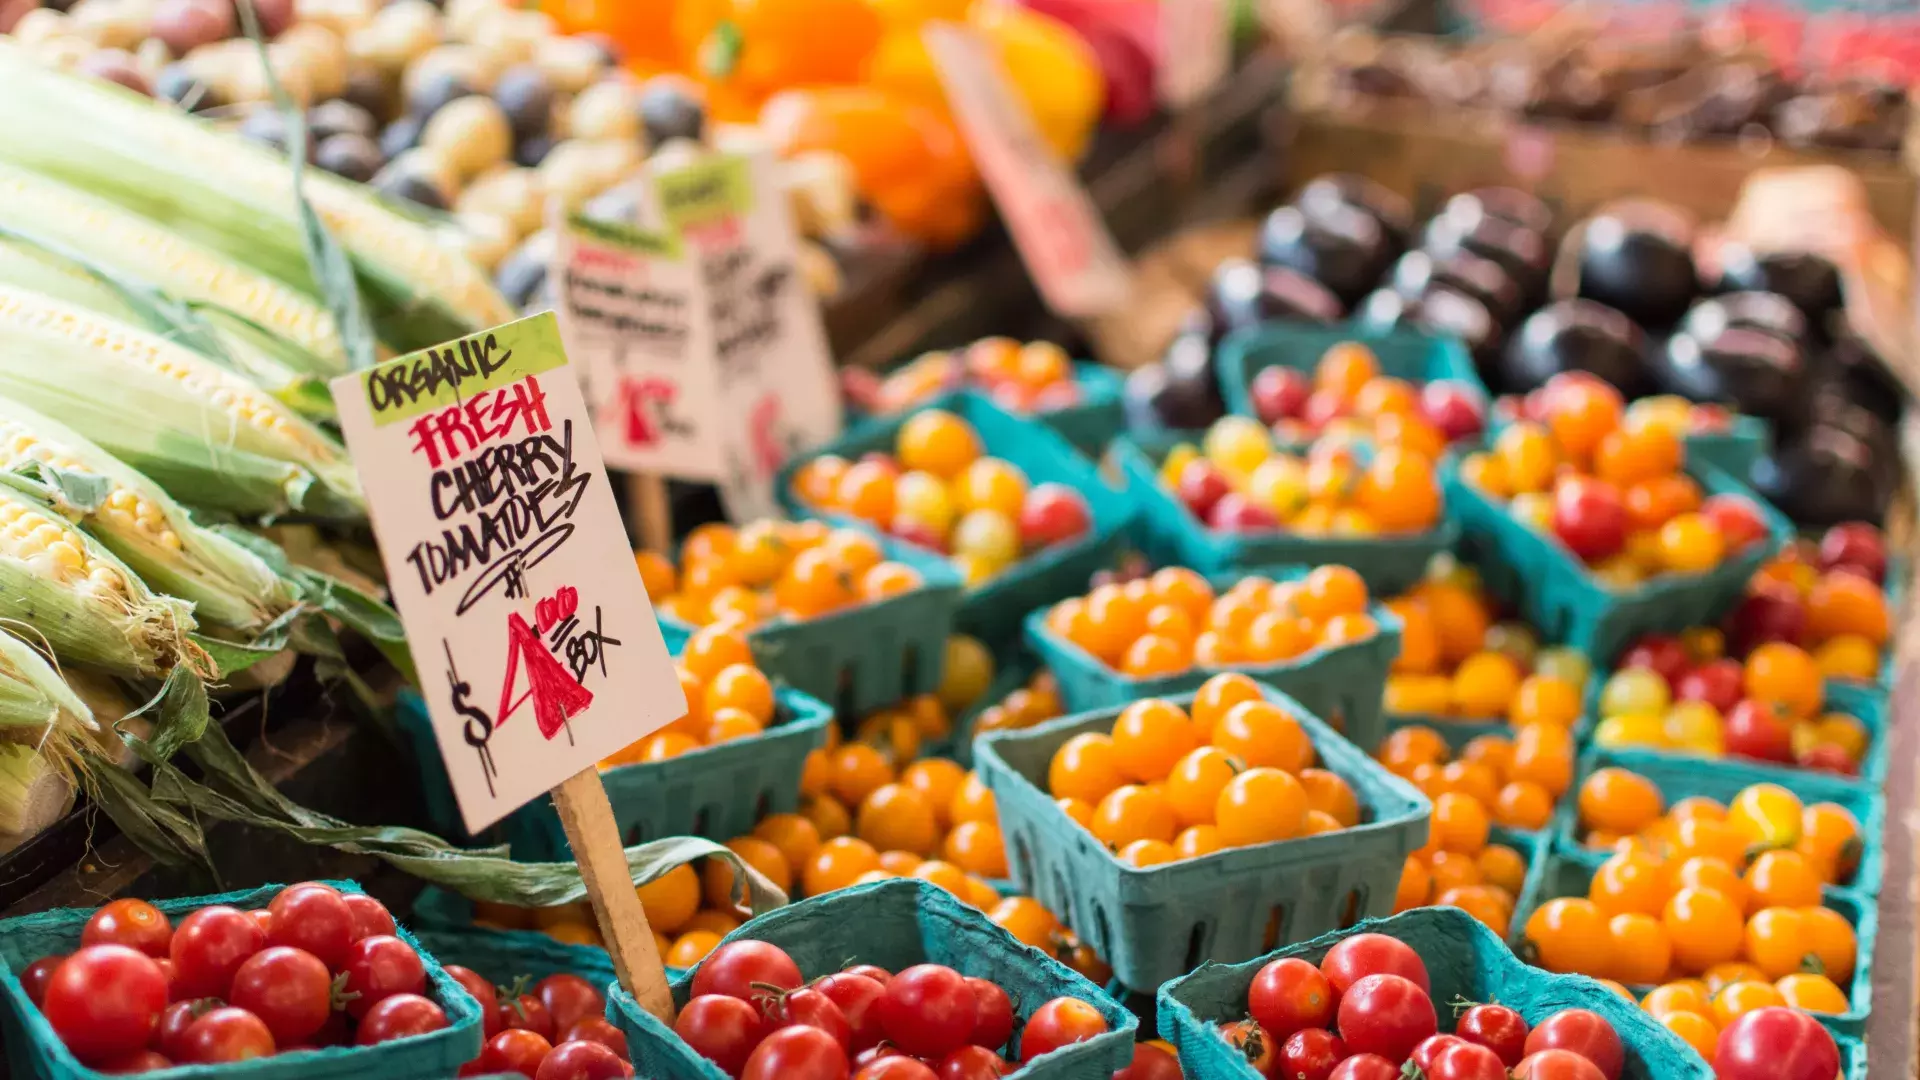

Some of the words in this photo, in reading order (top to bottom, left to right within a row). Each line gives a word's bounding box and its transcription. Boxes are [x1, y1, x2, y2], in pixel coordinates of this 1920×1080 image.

[368, 334, 512, 411] ORGANIC
[408, 375, 552, 468] FRESH
[431, 419, 572, 520] CHERRY
[406, 463, 592, 595] TOMATOES
[566, 605, 622, 684] BOX
